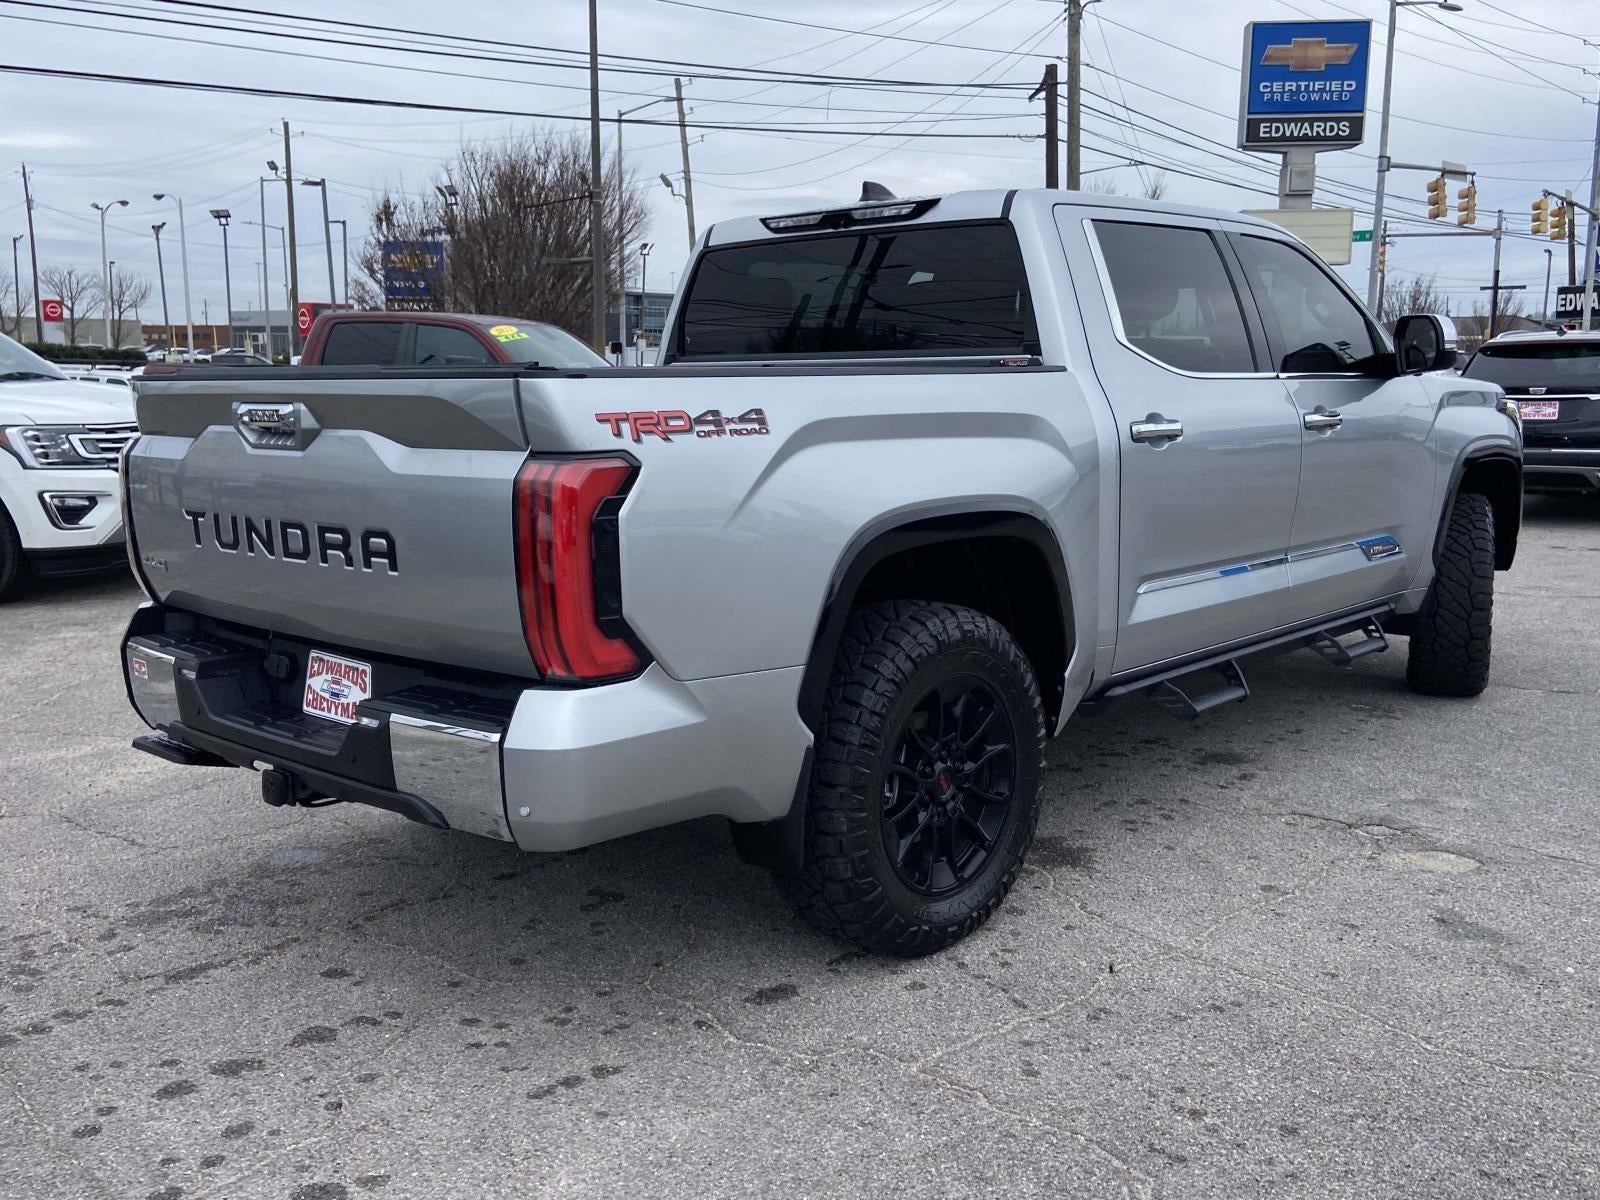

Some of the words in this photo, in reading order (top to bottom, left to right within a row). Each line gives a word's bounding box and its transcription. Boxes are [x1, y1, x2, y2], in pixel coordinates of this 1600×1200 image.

[1259, 80, 1356, 92] CERTIFIED
[1263, 92, 1350, 102] PRE-OWNED
[1259, 121, 1350, 138] EDWARDS
[1519, 402, 1558, 410] EDWARDS
[594, 409, 694, 444] TRD
[696, 430, 726, 438] OFF
[729, 426, 770, 437] ROAD
[182, 508, 399, 576] TUNDRA
[308, 655, 368, 694] EDWARDS
[305, 683, 358, 721] CHEVYMA
